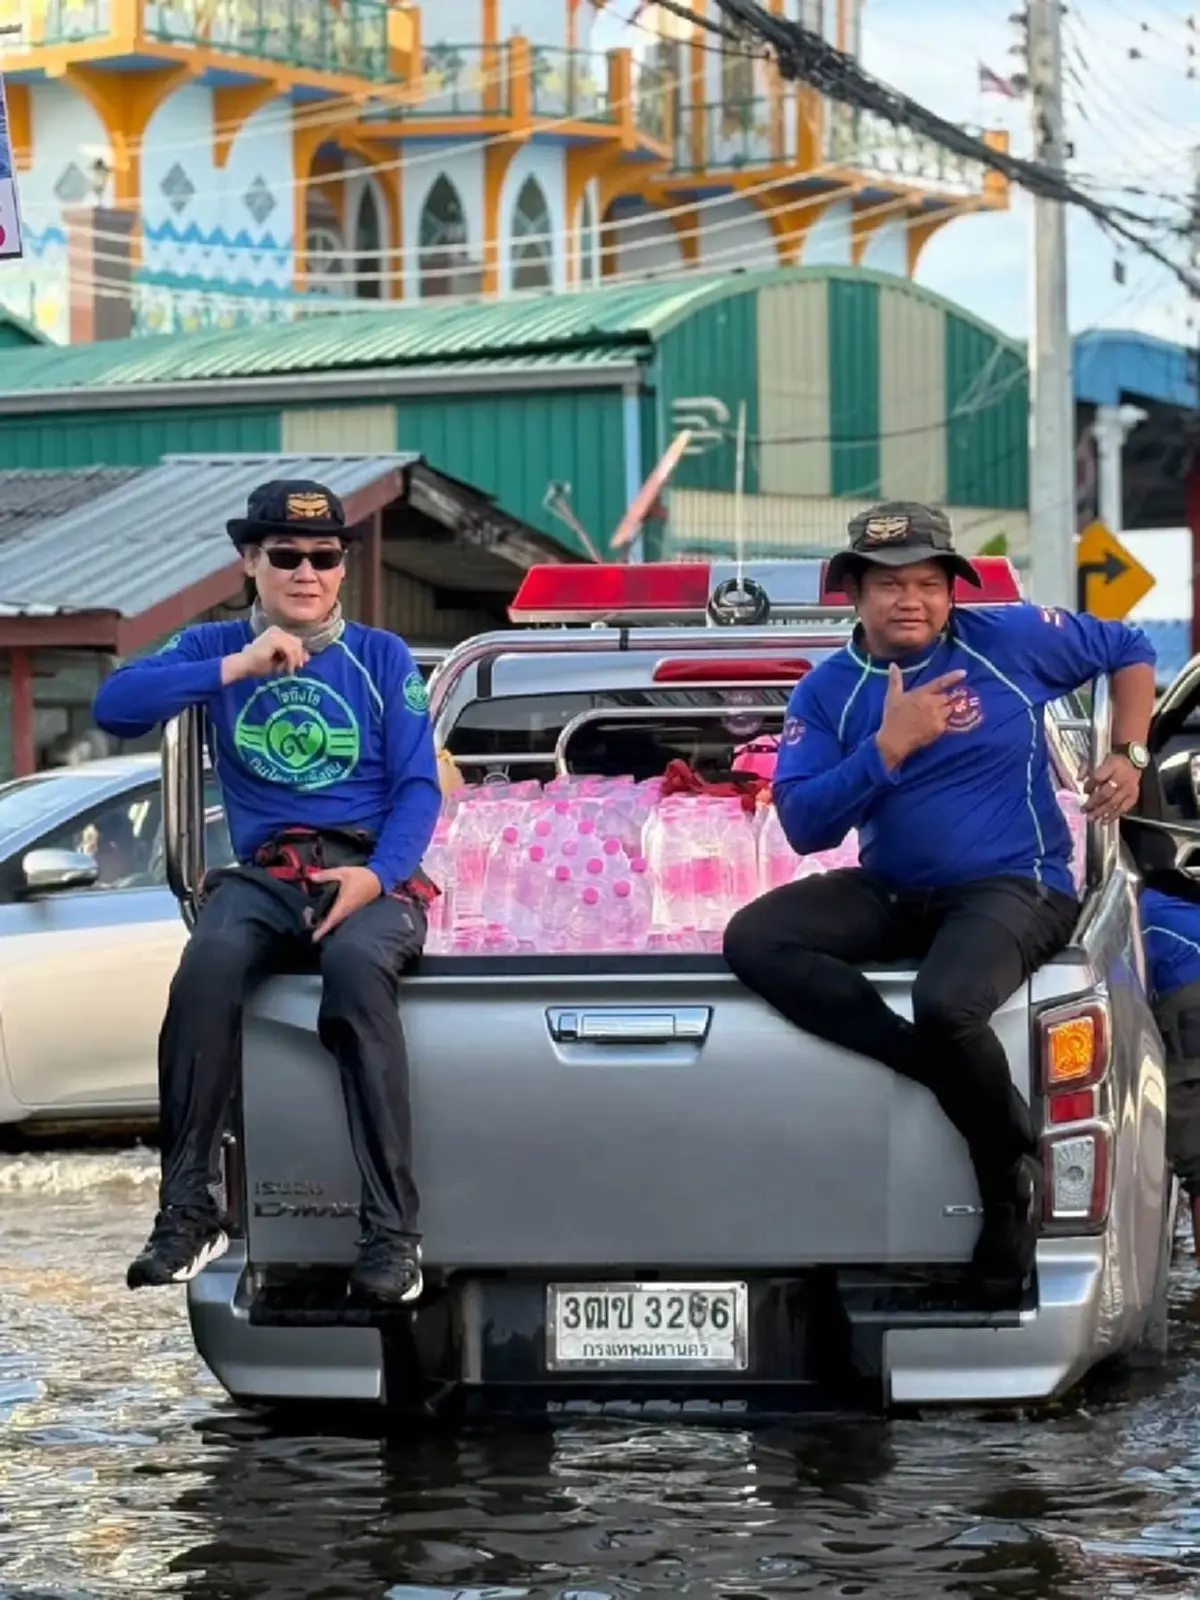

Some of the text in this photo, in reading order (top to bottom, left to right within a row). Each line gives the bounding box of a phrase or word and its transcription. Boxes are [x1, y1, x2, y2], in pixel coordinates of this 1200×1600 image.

[583, 1343, 709, 1357] กรงเทพมหานคร
